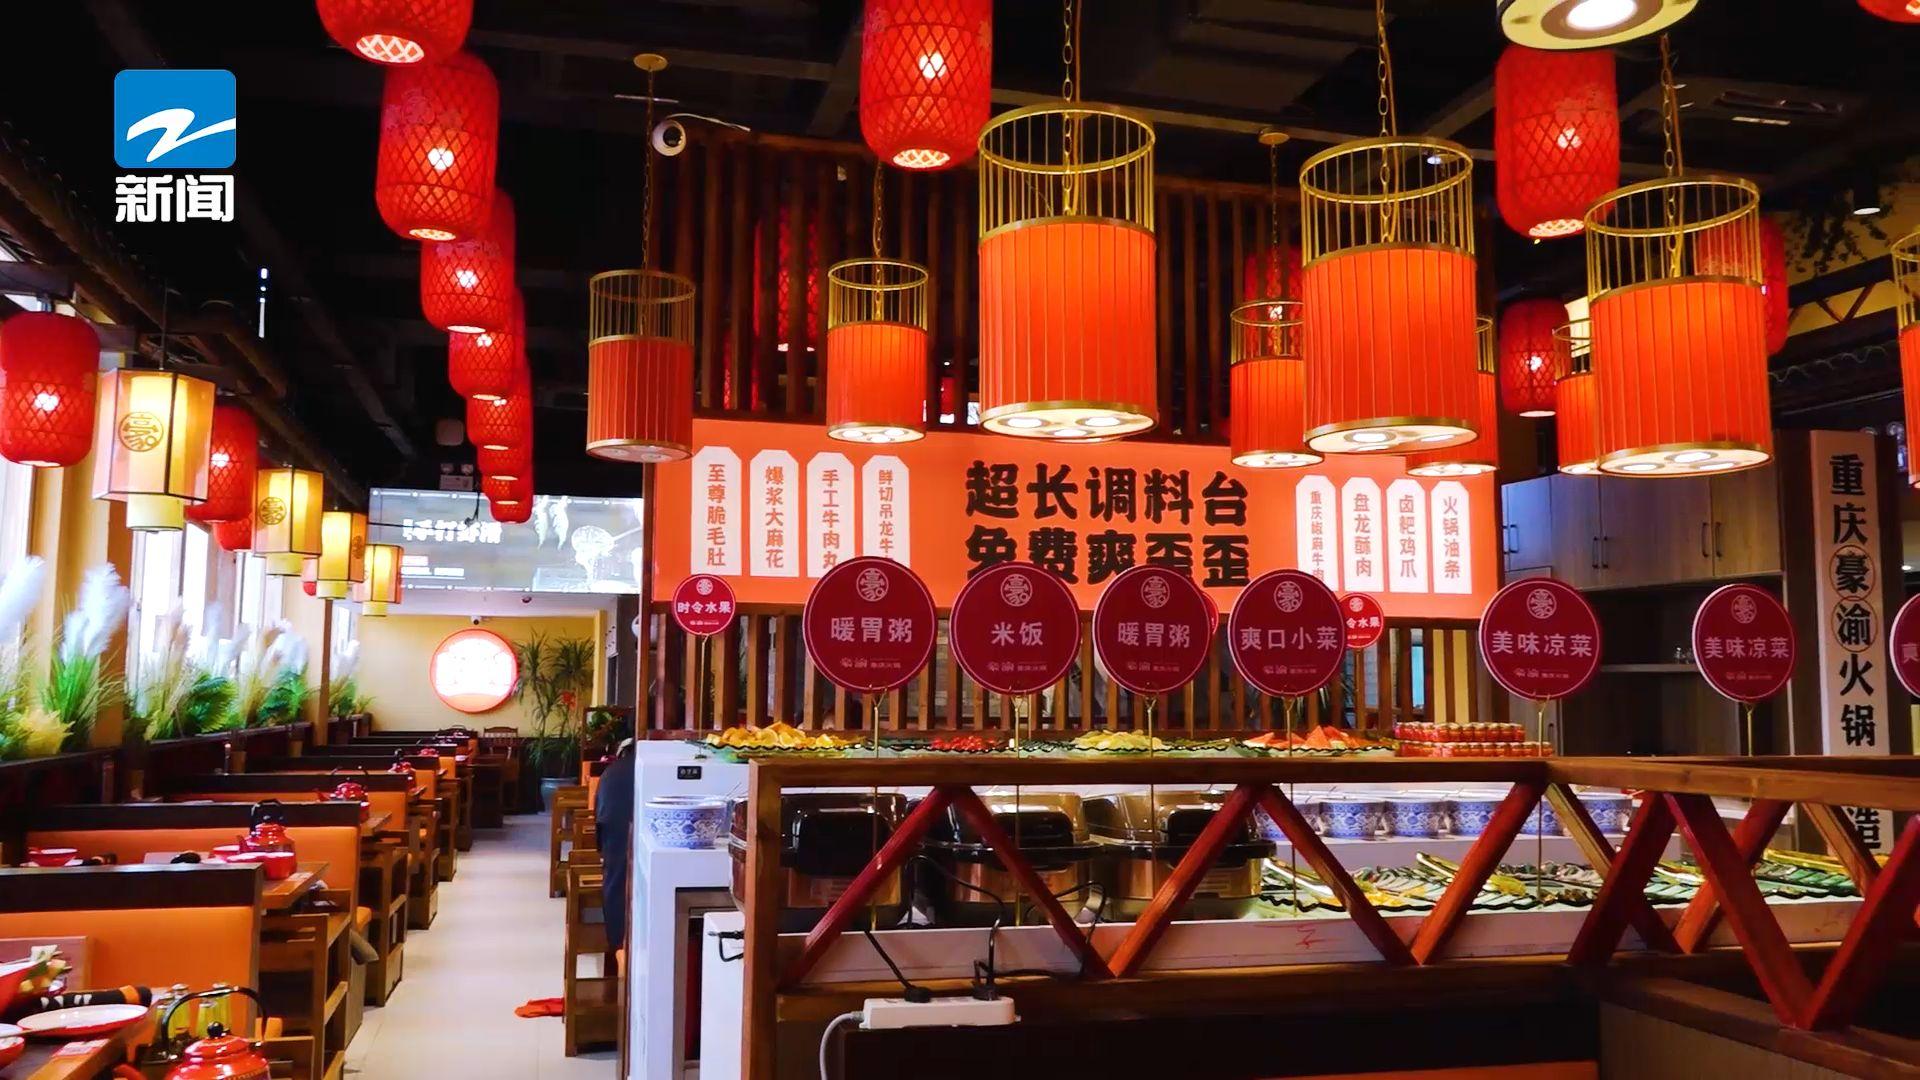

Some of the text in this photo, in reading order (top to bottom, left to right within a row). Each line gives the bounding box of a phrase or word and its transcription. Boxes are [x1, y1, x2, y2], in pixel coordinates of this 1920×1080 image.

[707, 463, 726, 567] 至尊脆毛肚
[765, 465, 784, 569] 爆浆大麻花
[822, 469, 840, 569] 手工牛肉丸
[878, 469, 894, 559] 鲜切吊龙牛
[965, 460, 1248, 526] 超长调料台
[965, 524, 1250, 588] 免费爽歪歪
[1353, 493, 1371, 577] 盘龙酥肉
[1443, 496, 1460, 579] 火锅油条
[677, 601, 731, 614] 时令水果
[831, 617, 912, 643] 暖胃粥
[991, 621, 1043, 646] 米饭
[1117, 621, 1190, 648] 暖胃粥
[1240, 625, 1338, 651] 爽口小菜
[1492, 630, 1593, 658] 美味凉菜
[1704, 636, 1790, 660] 美味凉菜
